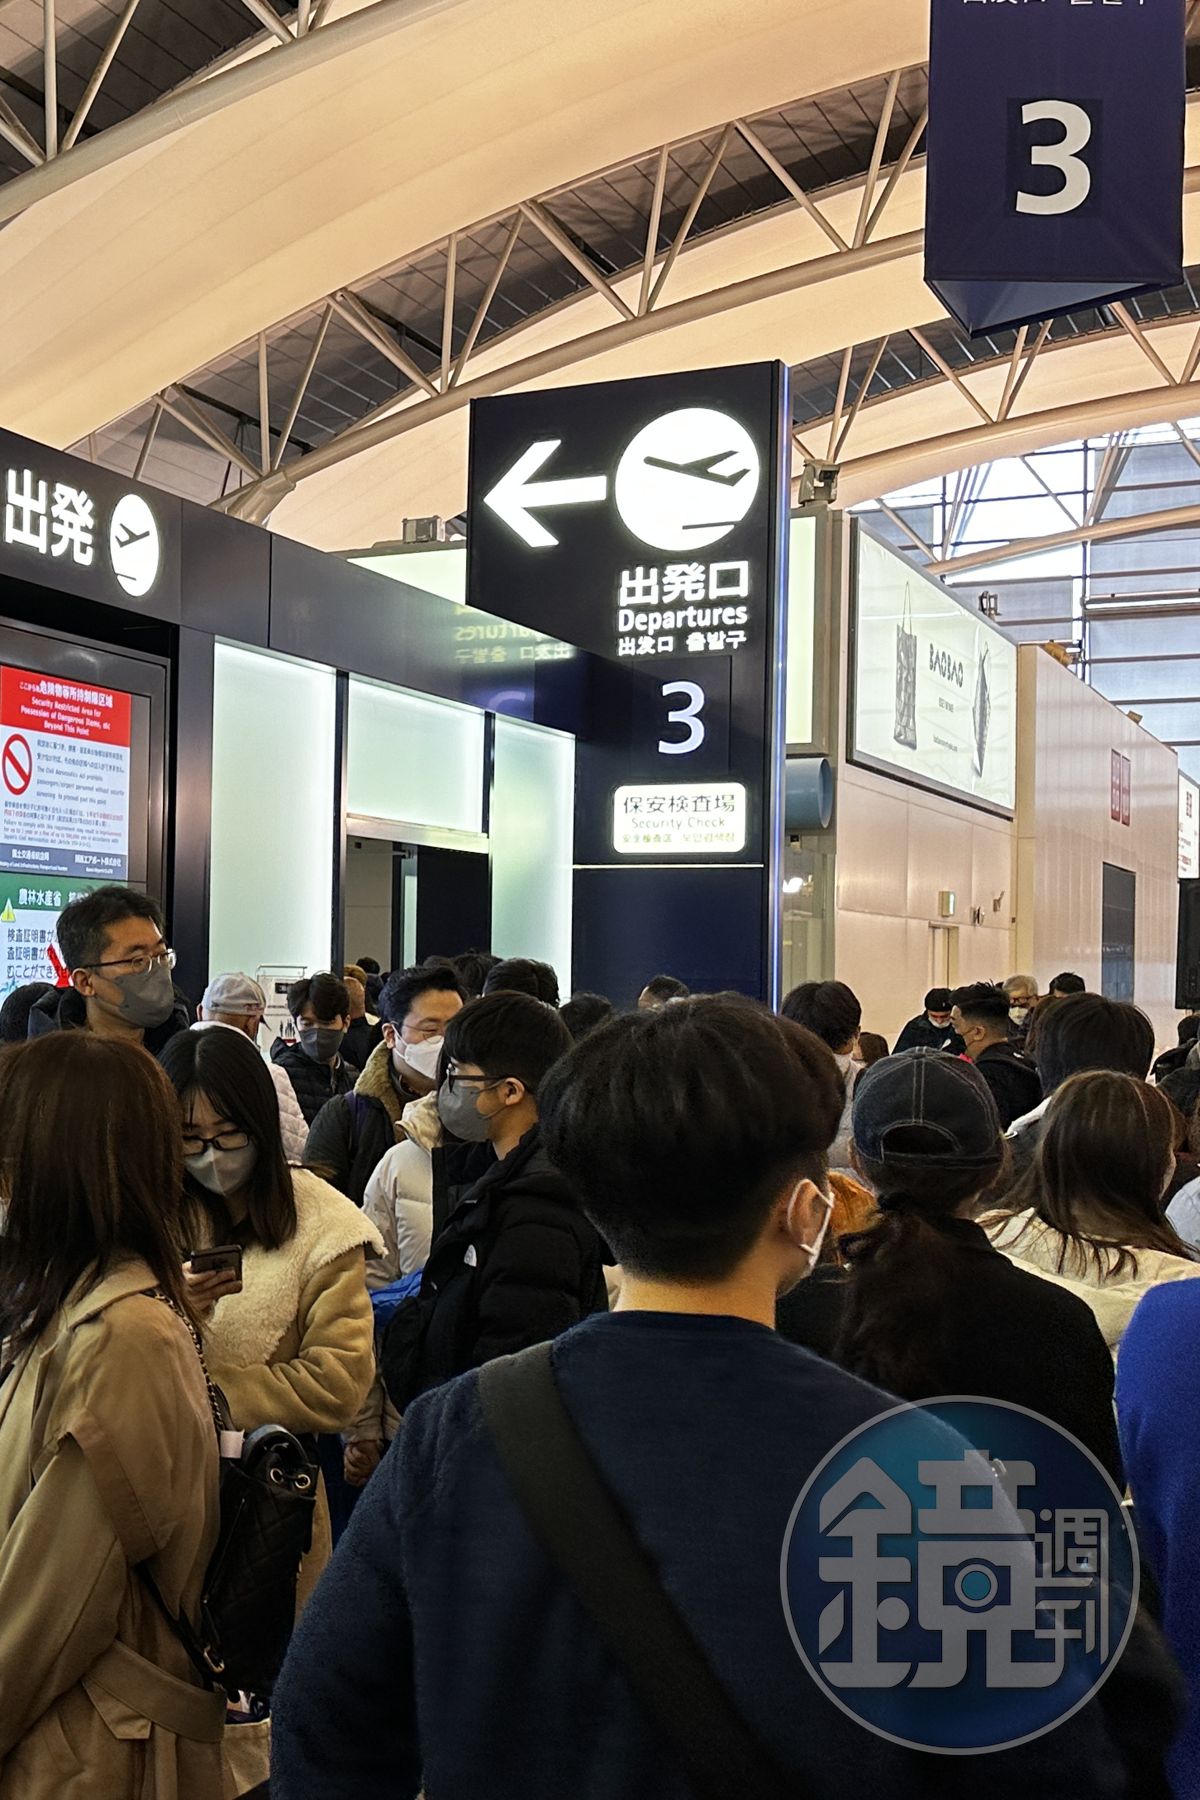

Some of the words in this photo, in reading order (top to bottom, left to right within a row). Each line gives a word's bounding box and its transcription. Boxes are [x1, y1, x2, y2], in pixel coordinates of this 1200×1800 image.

[1015, 100, 1092, 215] 3
[4, 467, 95, 567] 出発
[620, 560, 748, 607] 出発口
[618, 606, 748, 636] Departures
[619, 635, 673, 656] 出发口
[658, 680, 706, 754] 3
[624, 794, 735, 814] 保安検査場
[631, 817, 683, 830] Security
[18, 888, 62, 907] 農林水産省
[7, 928, 59, 943] 検査証明書が
[7, 946, 50, 961] 査証明書が
